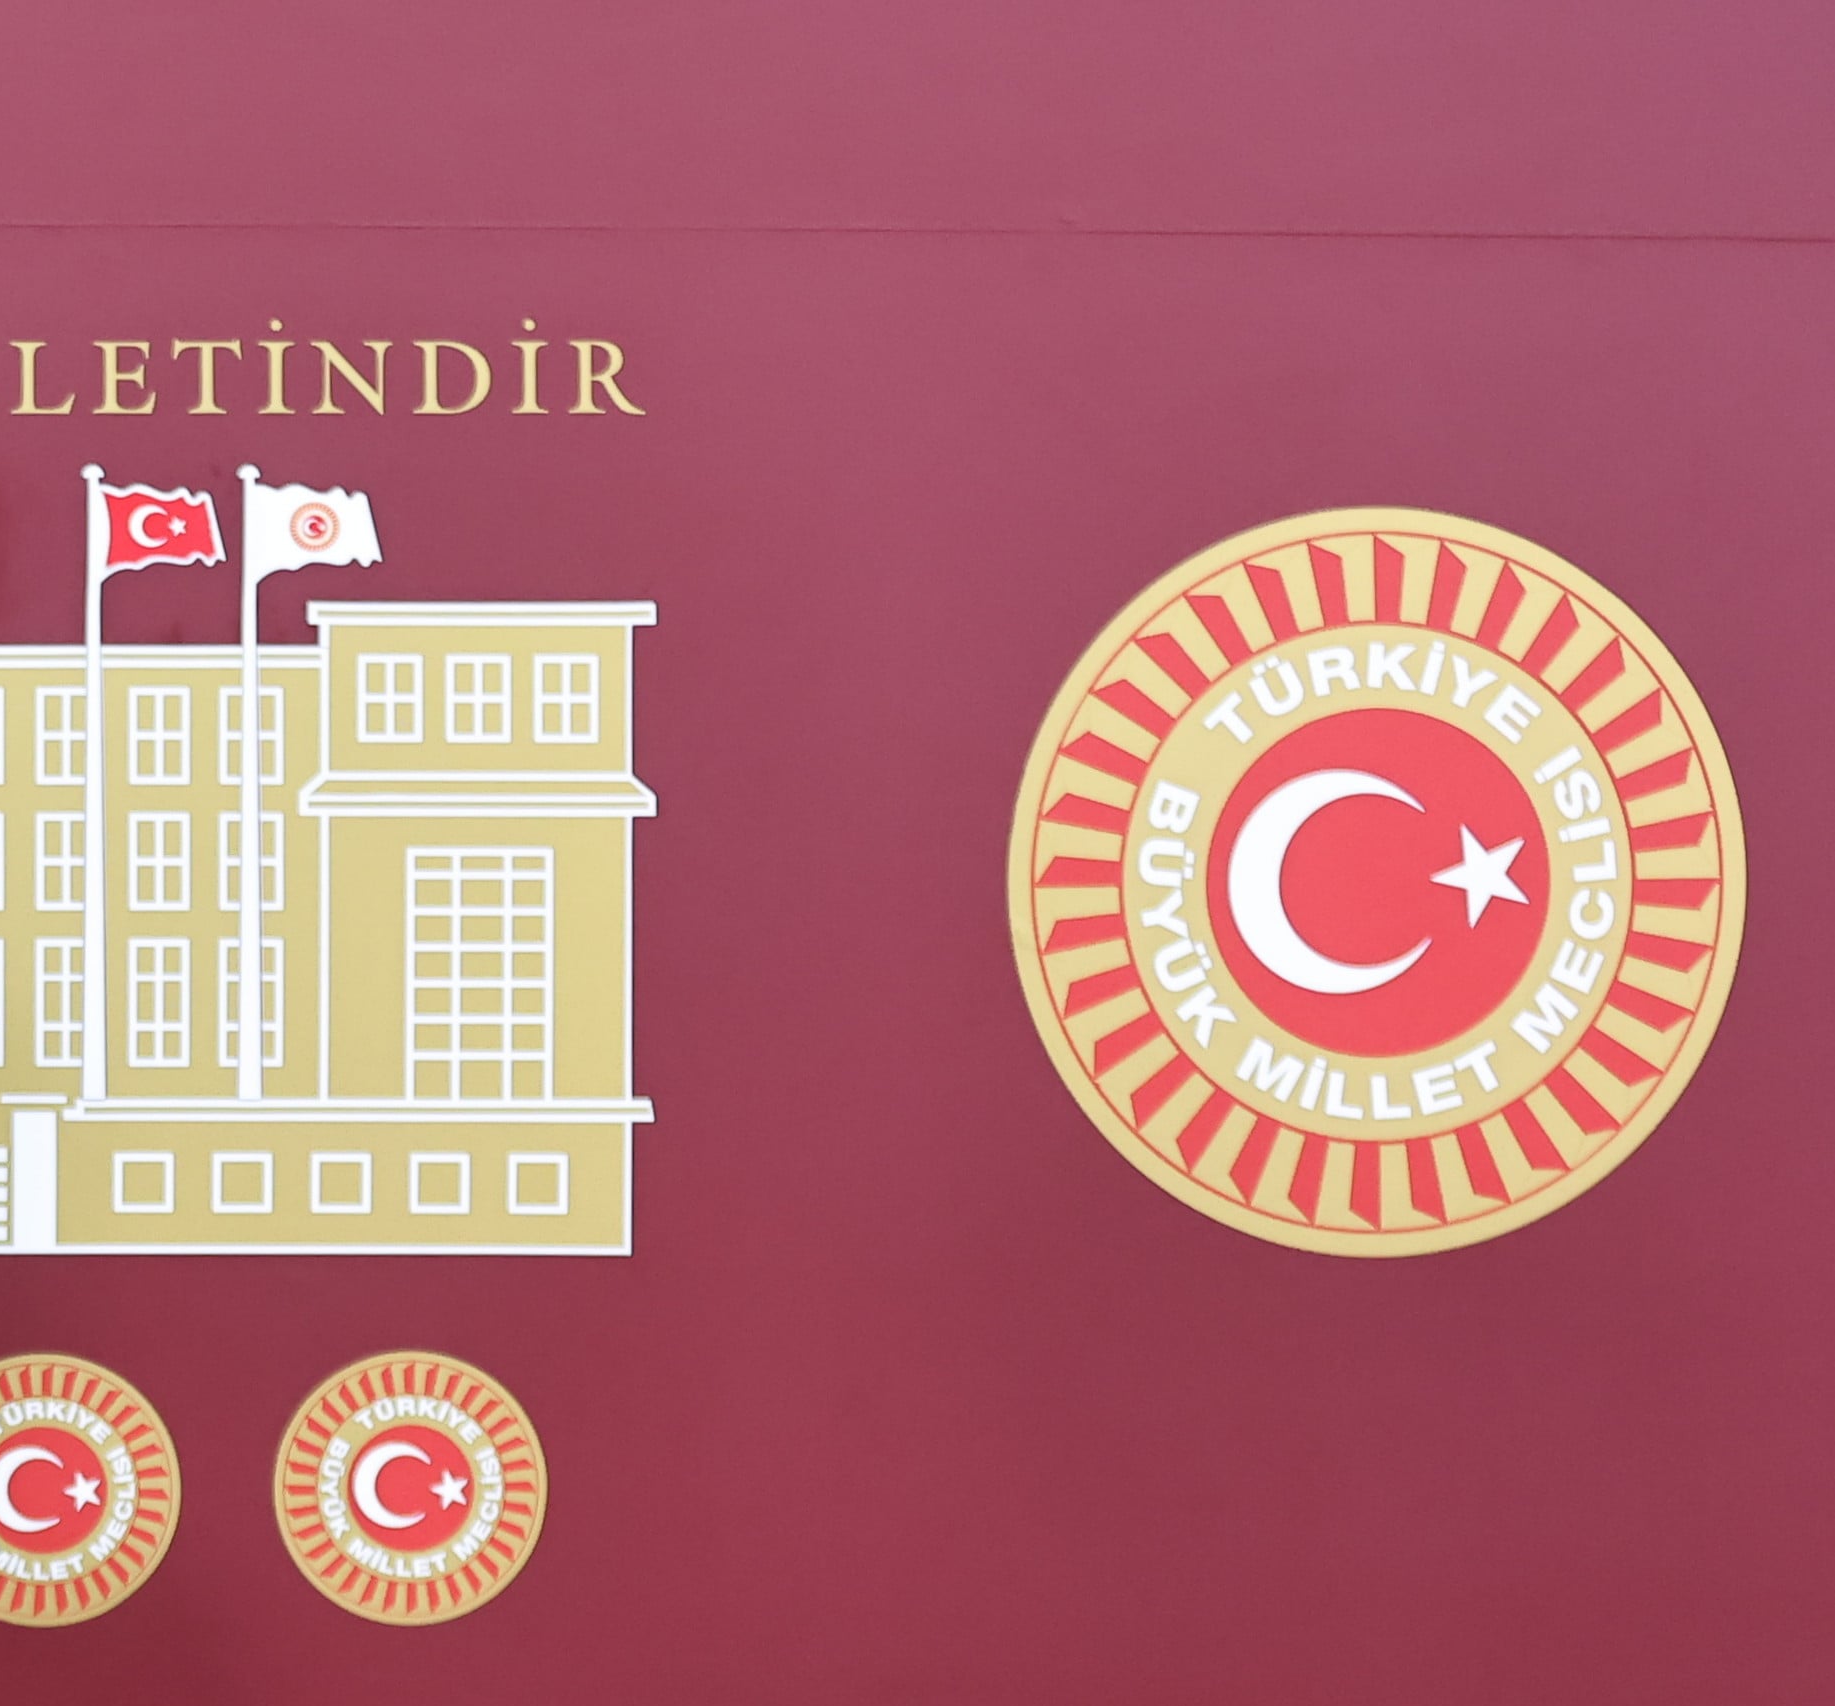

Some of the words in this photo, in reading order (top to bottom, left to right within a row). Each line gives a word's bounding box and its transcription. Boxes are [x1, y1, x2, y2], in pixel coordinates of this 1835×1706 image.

[1204, 641, 1541, 743] TÜRKİYE
[1139, 781, 1236, 1047] BÜYÜK
[1237, 1038, 1498, 1119] MİLLET
